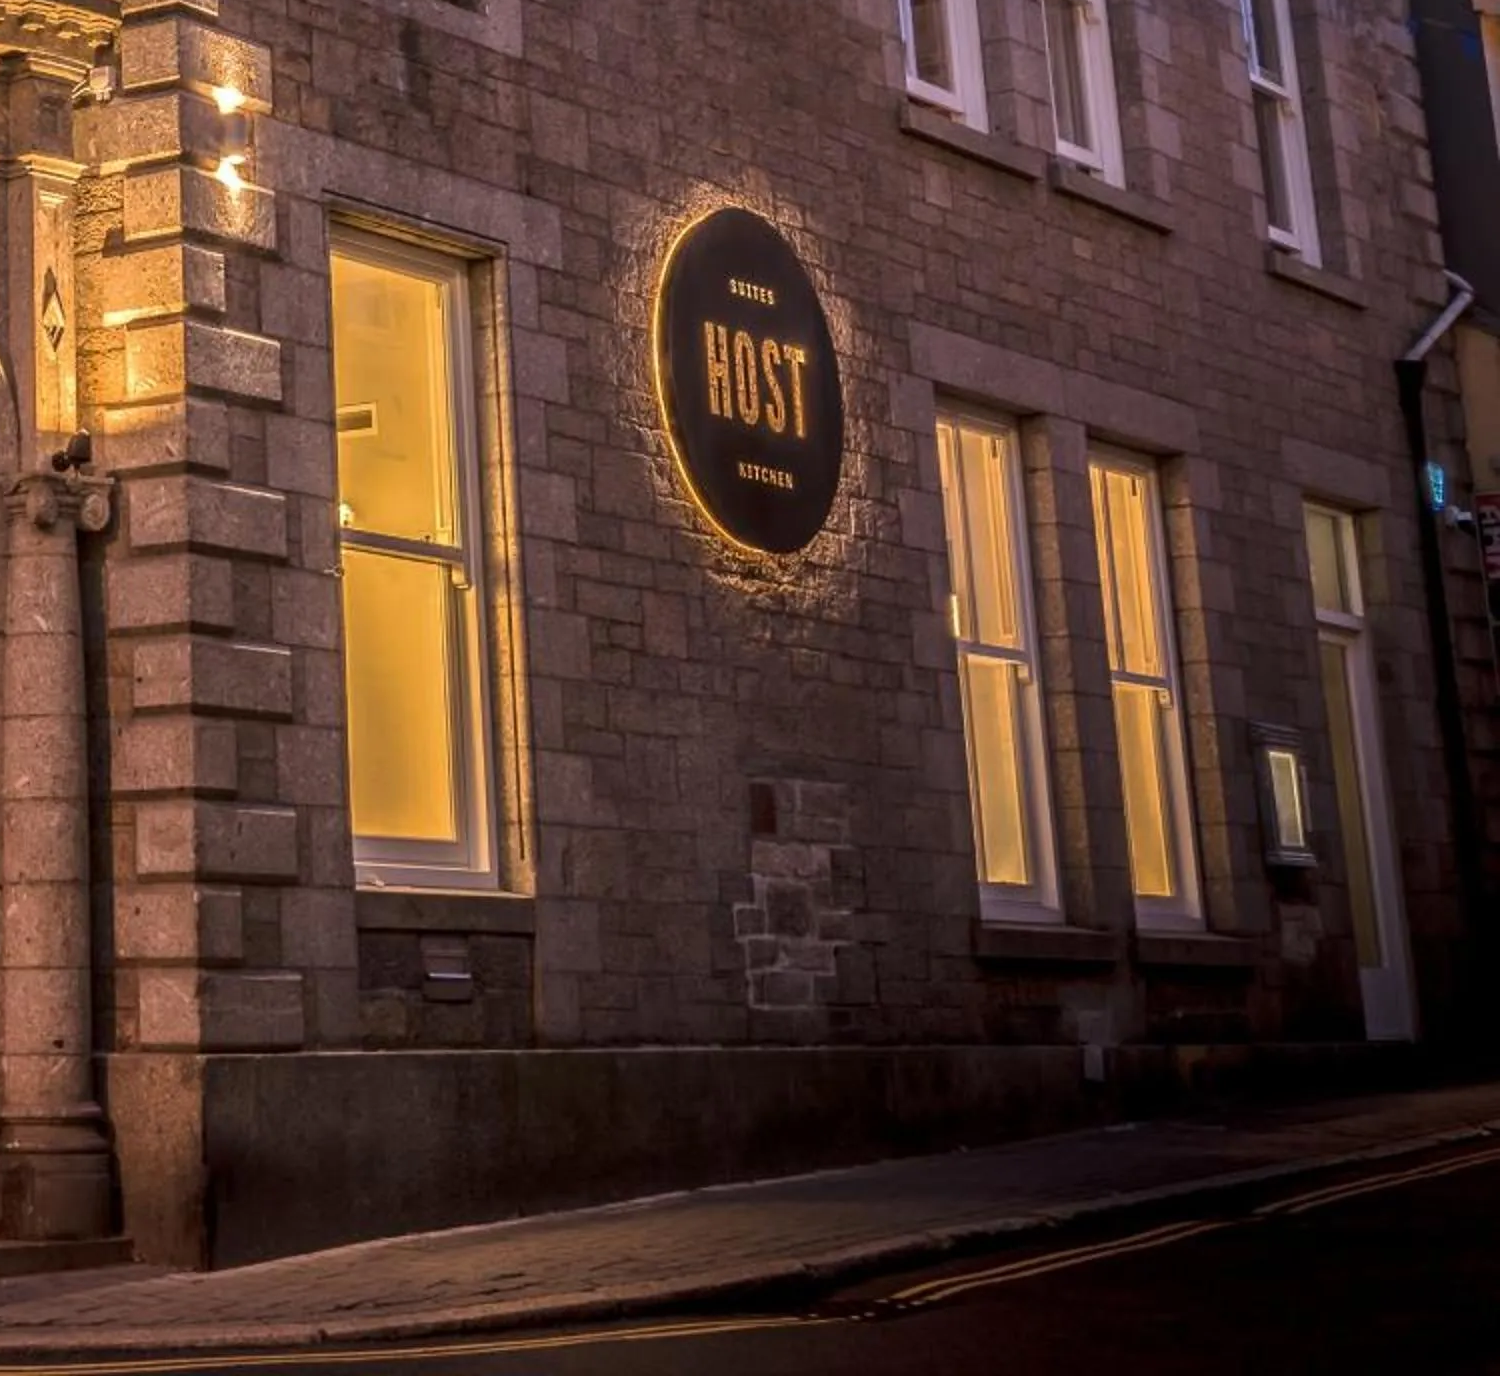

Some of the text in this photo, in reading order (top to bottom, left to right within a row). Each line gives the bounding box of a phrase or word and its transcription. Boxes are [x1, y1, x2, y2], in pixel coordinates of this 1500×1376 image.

[729, 278, 775, 305] SUITES
[704, 321, 807, 438] HOST
[738, 461, 794, 489] KITCHEN
